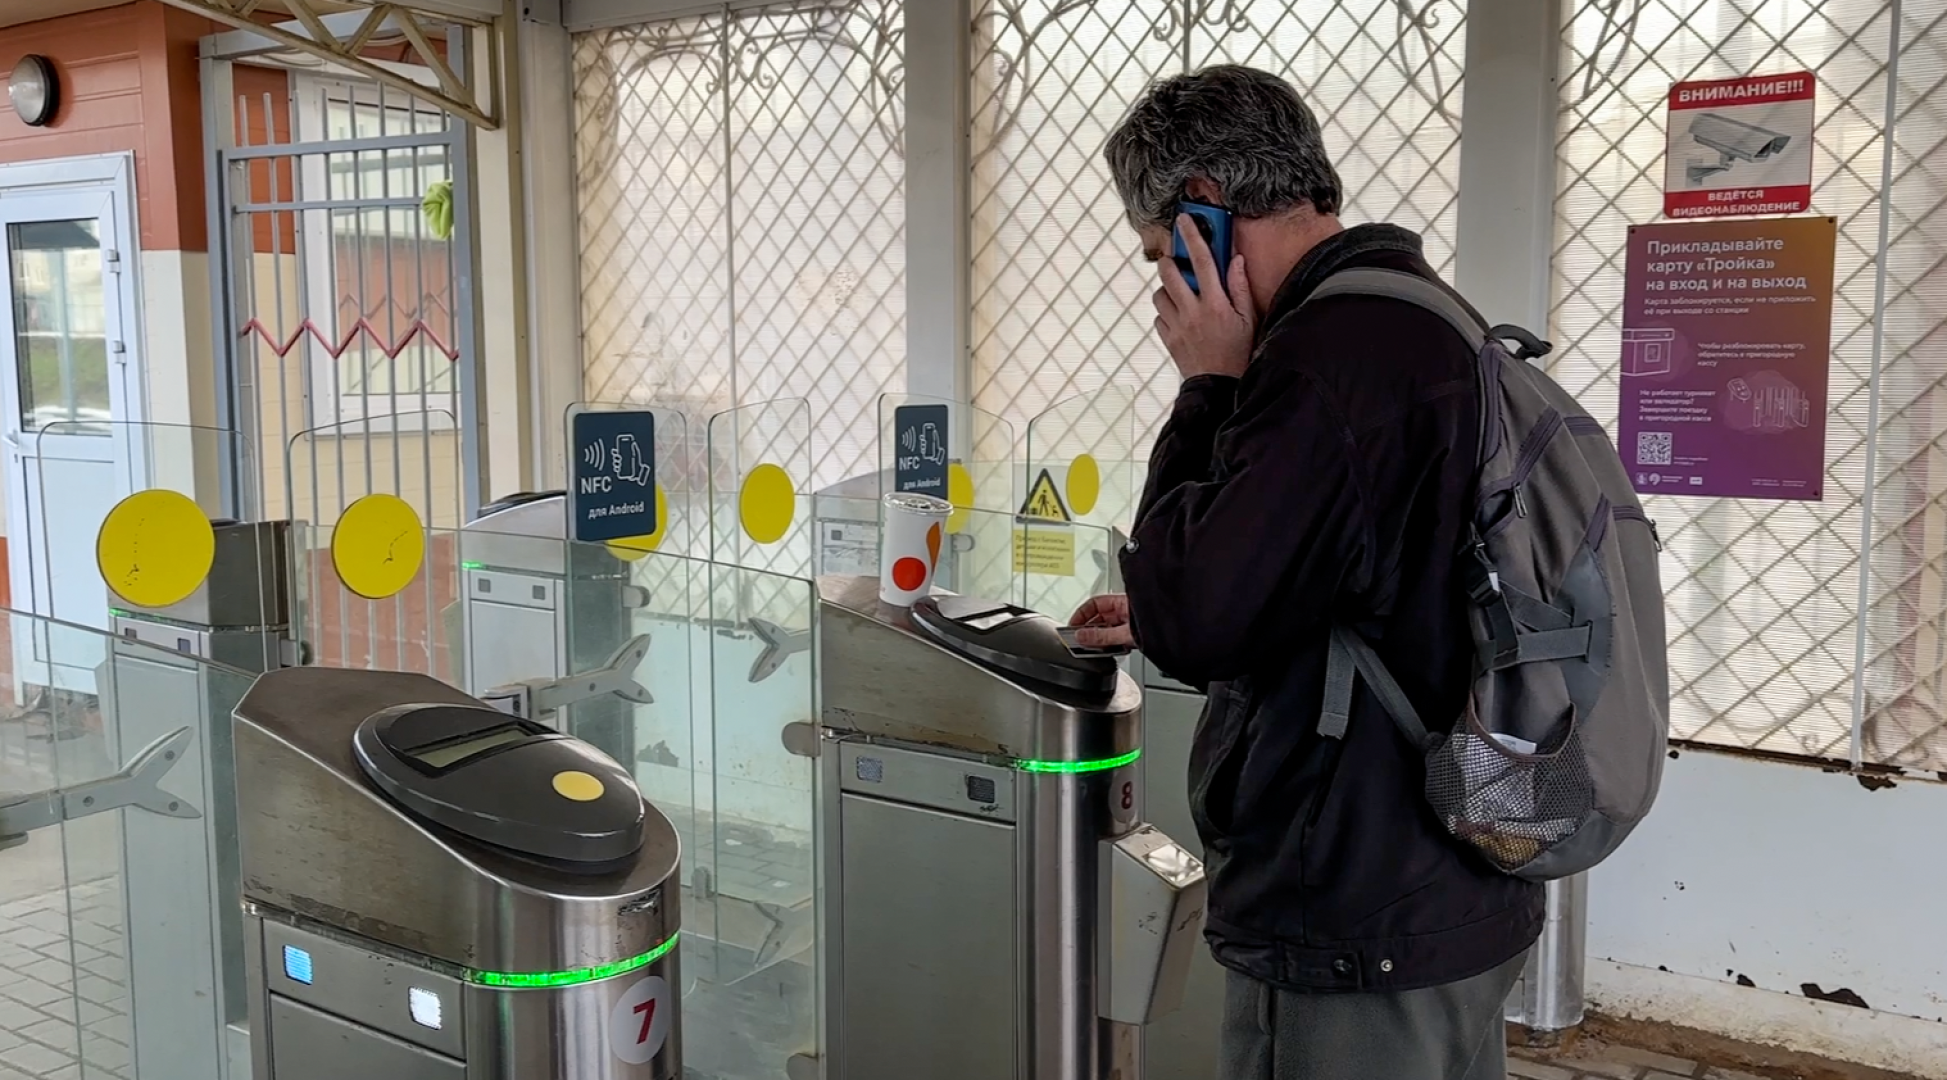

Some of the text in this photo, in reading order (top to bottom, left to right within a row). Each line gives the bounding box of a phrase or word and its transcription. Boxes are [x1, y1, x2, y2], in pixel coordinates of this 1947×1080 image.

[1679, 79, 1804, 102] ВНИМАНИЕ!!!
[1708, 190, 1764, 202] ВЕДЁТСЯ
[1673, 202, 1800, 216] ВИДЕОНАБЛЮДЕНИЕ
[1647, 237, 1784, 256] Прикладывайте
[1647, 257, 1775, 275] карту «Тройка»
[1646, 276, 1807, 291] на вход и на выход
[1644, 298, 1668, 306] Карта
[1656, 308, 1671, 316] при
[899, 456, 920, 471] NFC
[581, 476, 612, 495] NFC
[903, 477, 941, 490] для Android
[588, 501, 645, 519] для Android
[1121, 781, 1133, 810] 8
[633, 998, 656, 1045] 7
